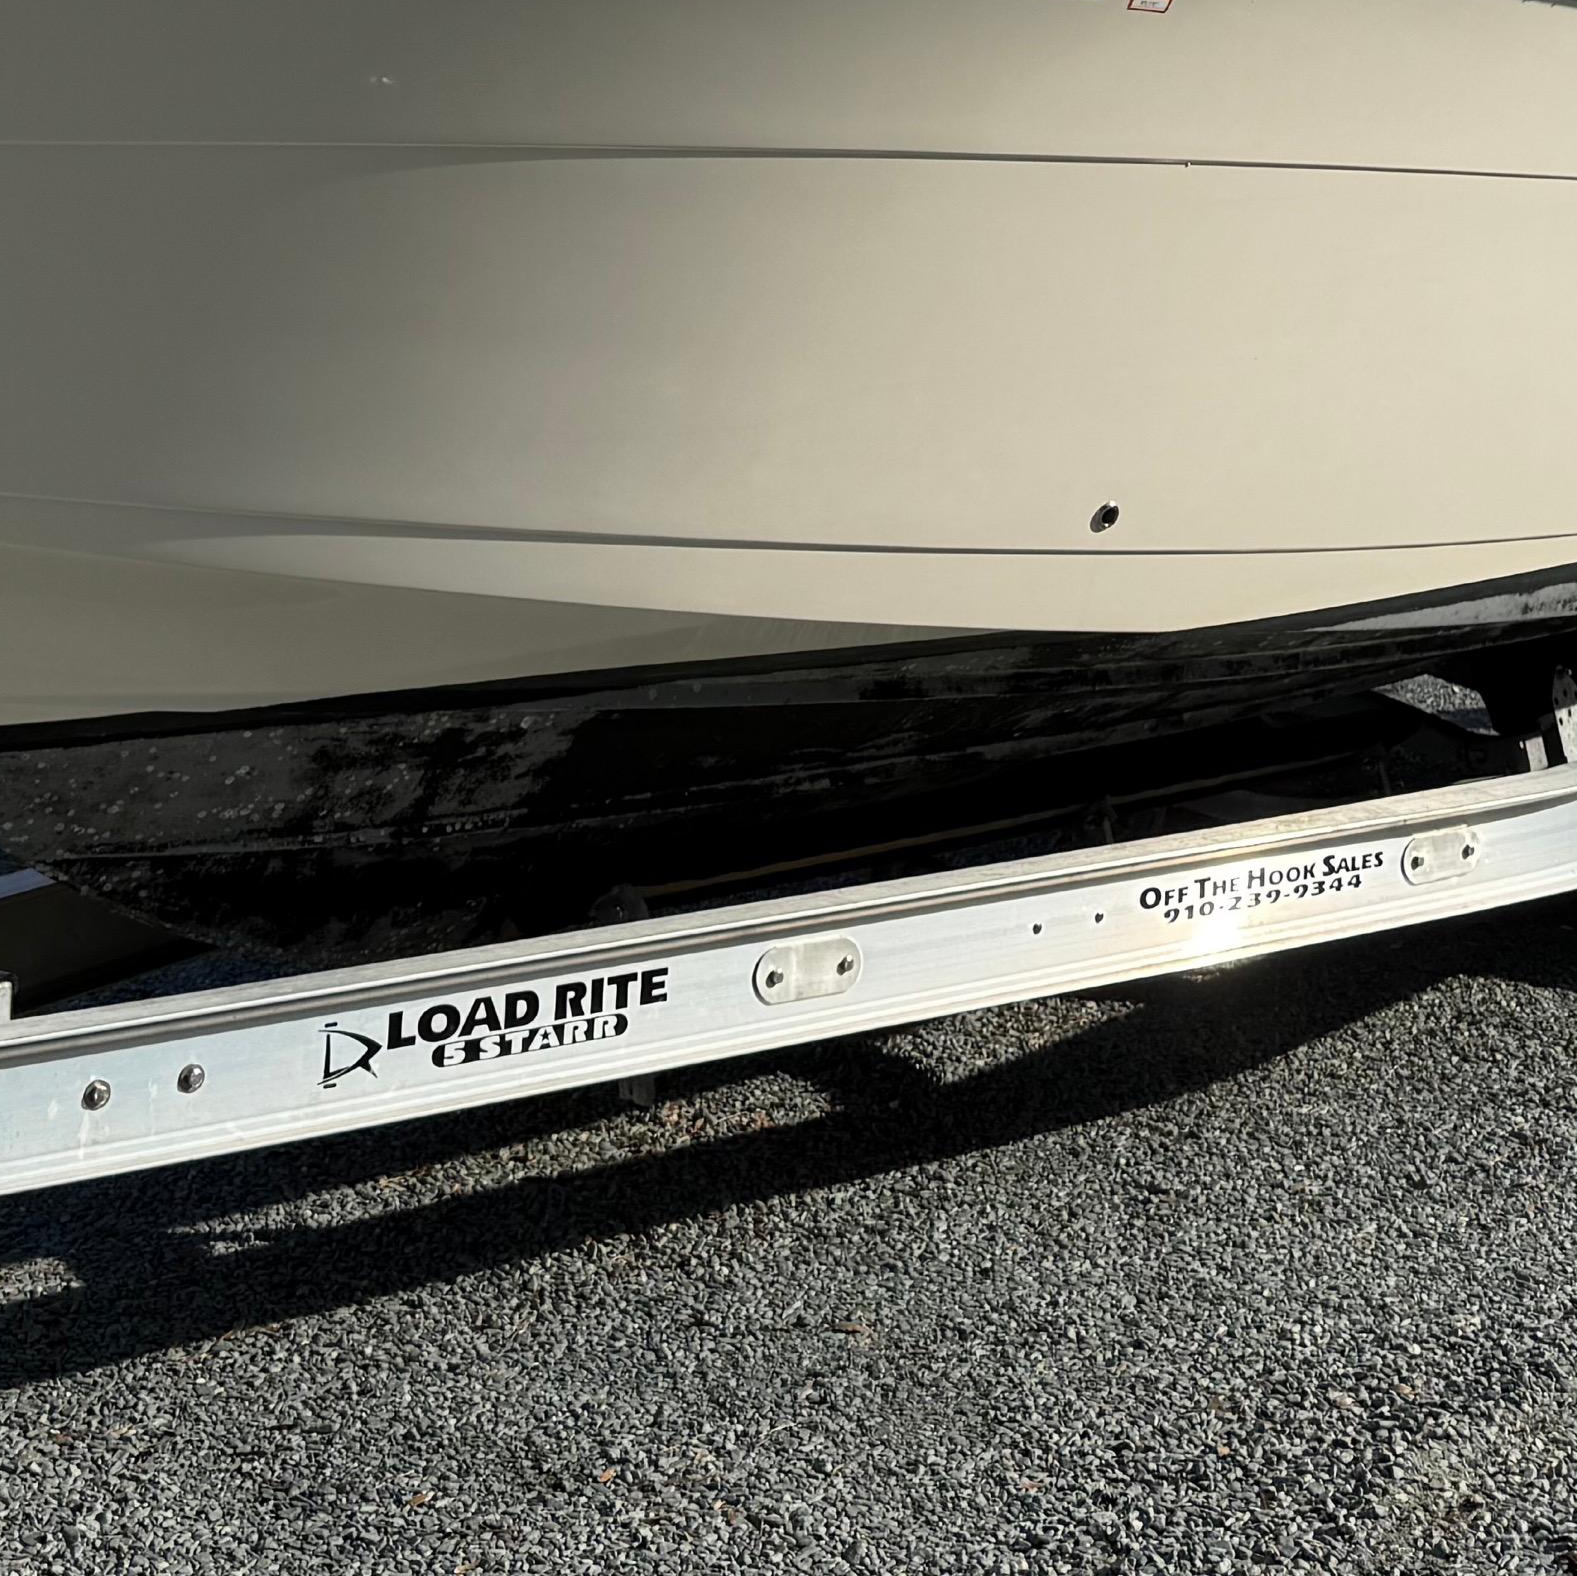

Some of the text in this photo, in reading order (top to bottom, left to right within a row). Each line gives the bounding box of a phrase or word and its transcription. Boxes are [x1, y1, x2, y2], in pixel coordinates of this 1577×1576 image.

[1163, 874, 1362, 924] 910-239-9344
[387, 967, 669, 1050] LOAD RITE
[442, 1013, 620, 1067] 5 STARR
